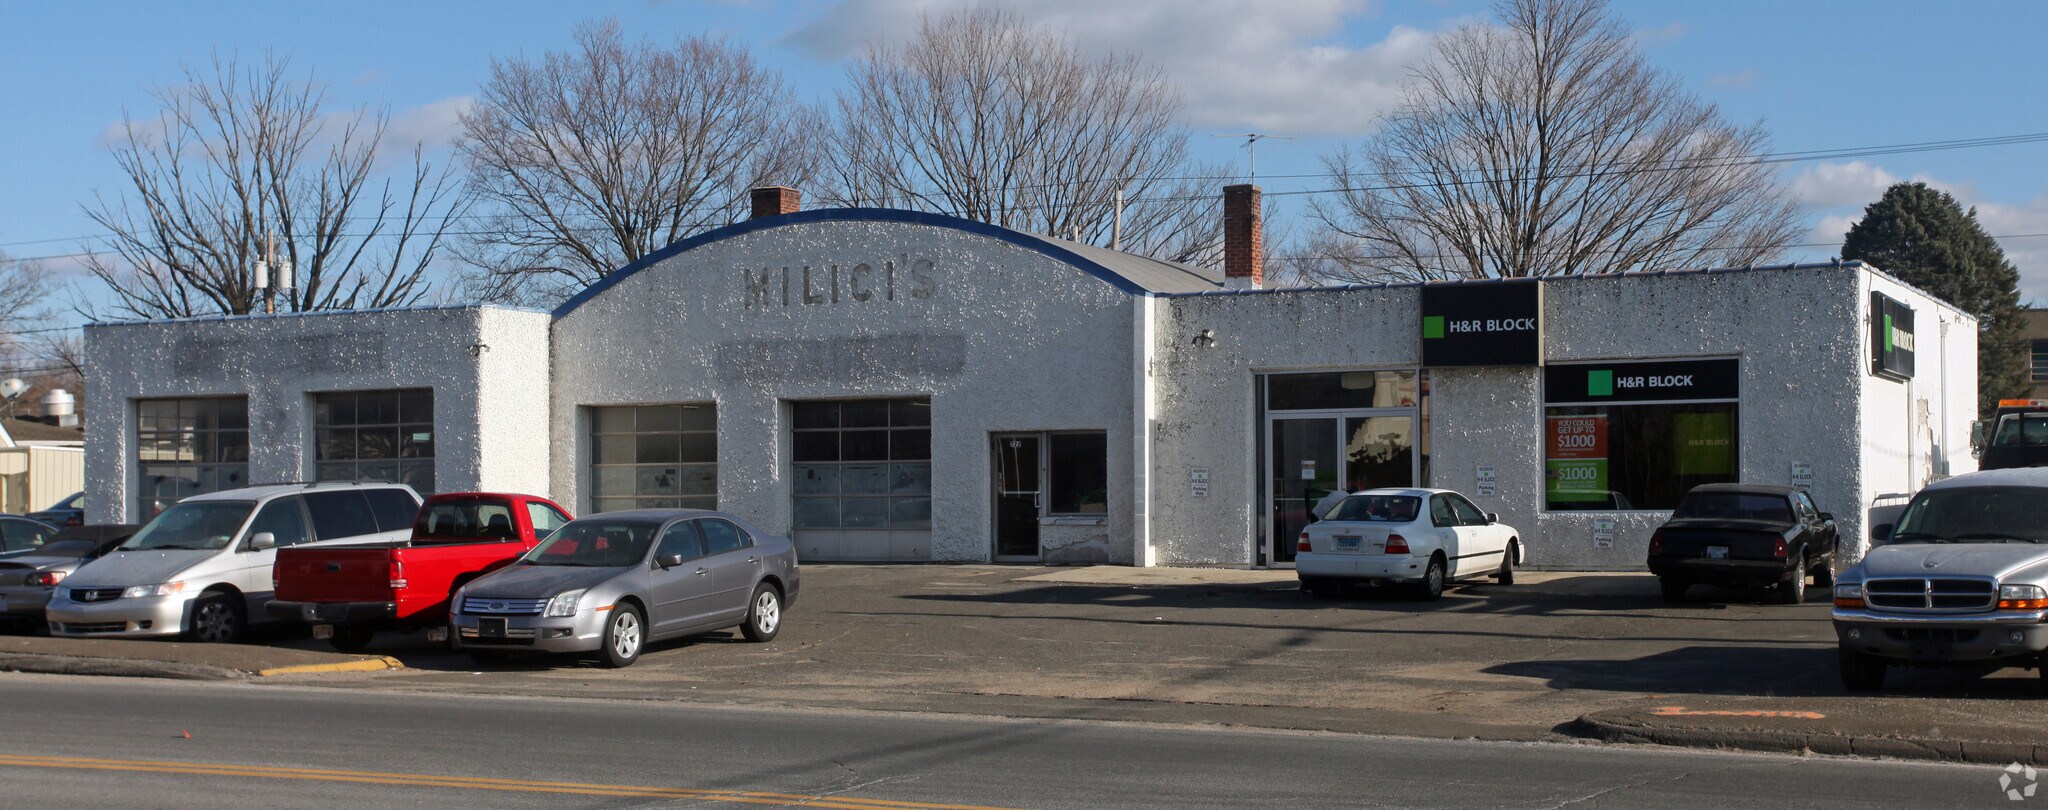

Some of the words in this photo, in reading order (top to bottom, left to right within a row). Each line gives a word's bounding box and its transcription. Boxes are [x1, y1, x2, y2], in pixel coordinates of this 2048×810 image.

[743, 253, 936, 309] MILICI'S
[1450, 320, 1481, 332] H&R
[1486, 318, 1535, 331] BLOCK
[1617, 376, 1645, 388] H&R
[1649, 375, 1693, 387] BLOCK
[1558, 434, 1595, 448] $1000
[1706, 438, 1729, 446] BLOCK
[1558, 466, 1597, 480] $1000
